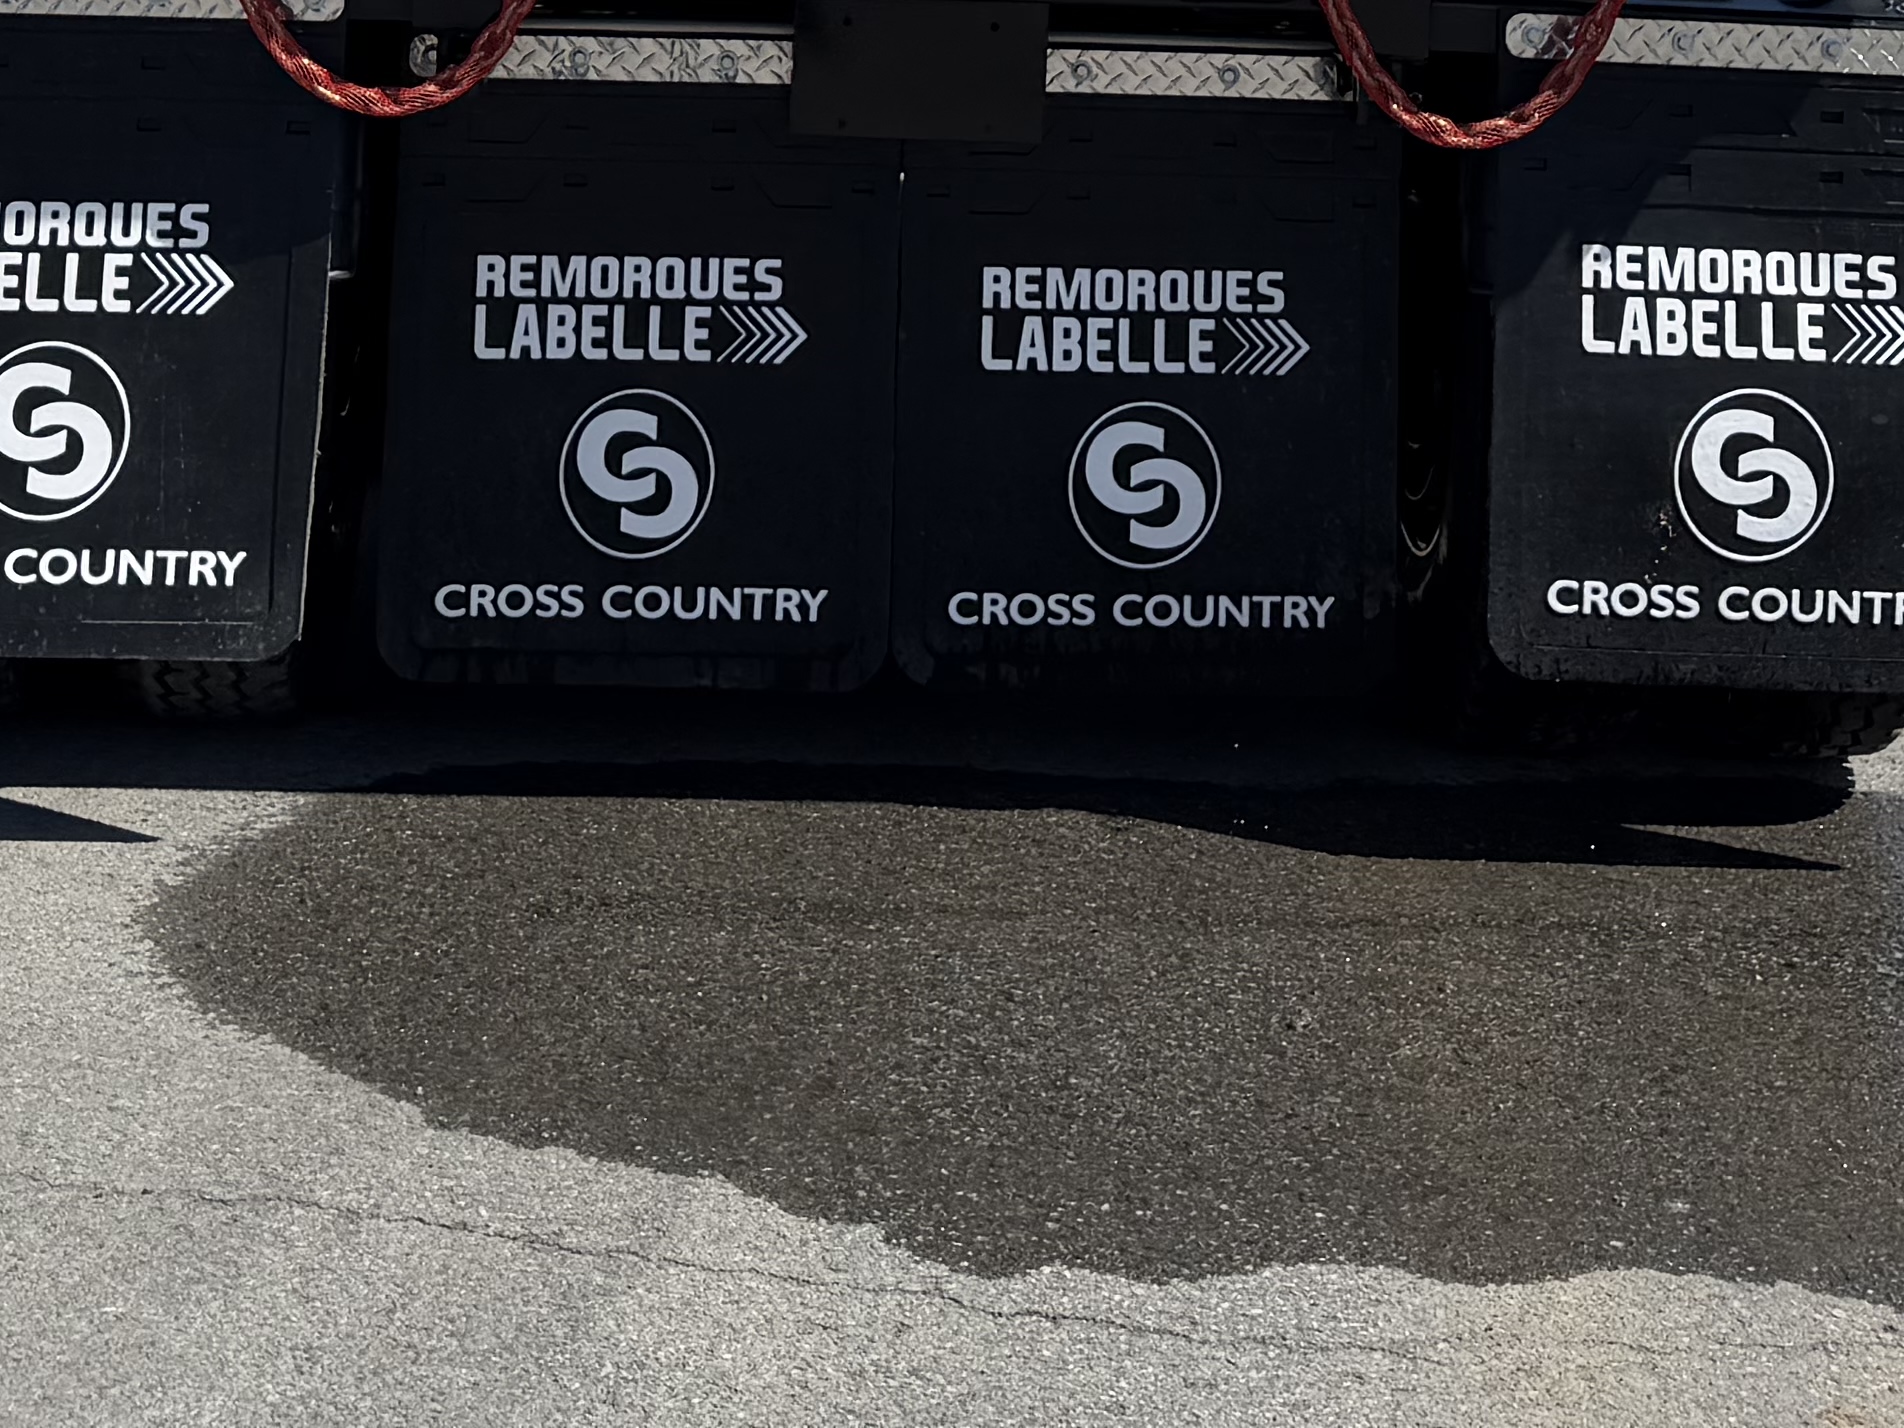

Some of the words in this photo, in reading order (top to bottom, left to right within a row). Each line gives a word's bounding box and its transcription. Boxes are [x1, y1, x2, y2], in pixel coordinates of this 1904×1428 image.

[475, 254, 783, 301] REMORQUES
[982, 266, 1285, 313] REMORQUES
[1581, 244, 1897, 300] REMORQUES
[474, 304, 711, 362] LABELLE
[981, 315, 1216, 374] LABELLE
[1580, 294, 1826, 362] LABELLE
[4, 547, 246, 586] COUNTRY
[435, 584, 584, 618] CROSS
[602, 585, 828, 622] COUNTRY
[948, 592, 1095, 626] CROSS
[1112, 594, 1335, 628] COUNTRY
[1547, 579, 1700, 620] CROSS
